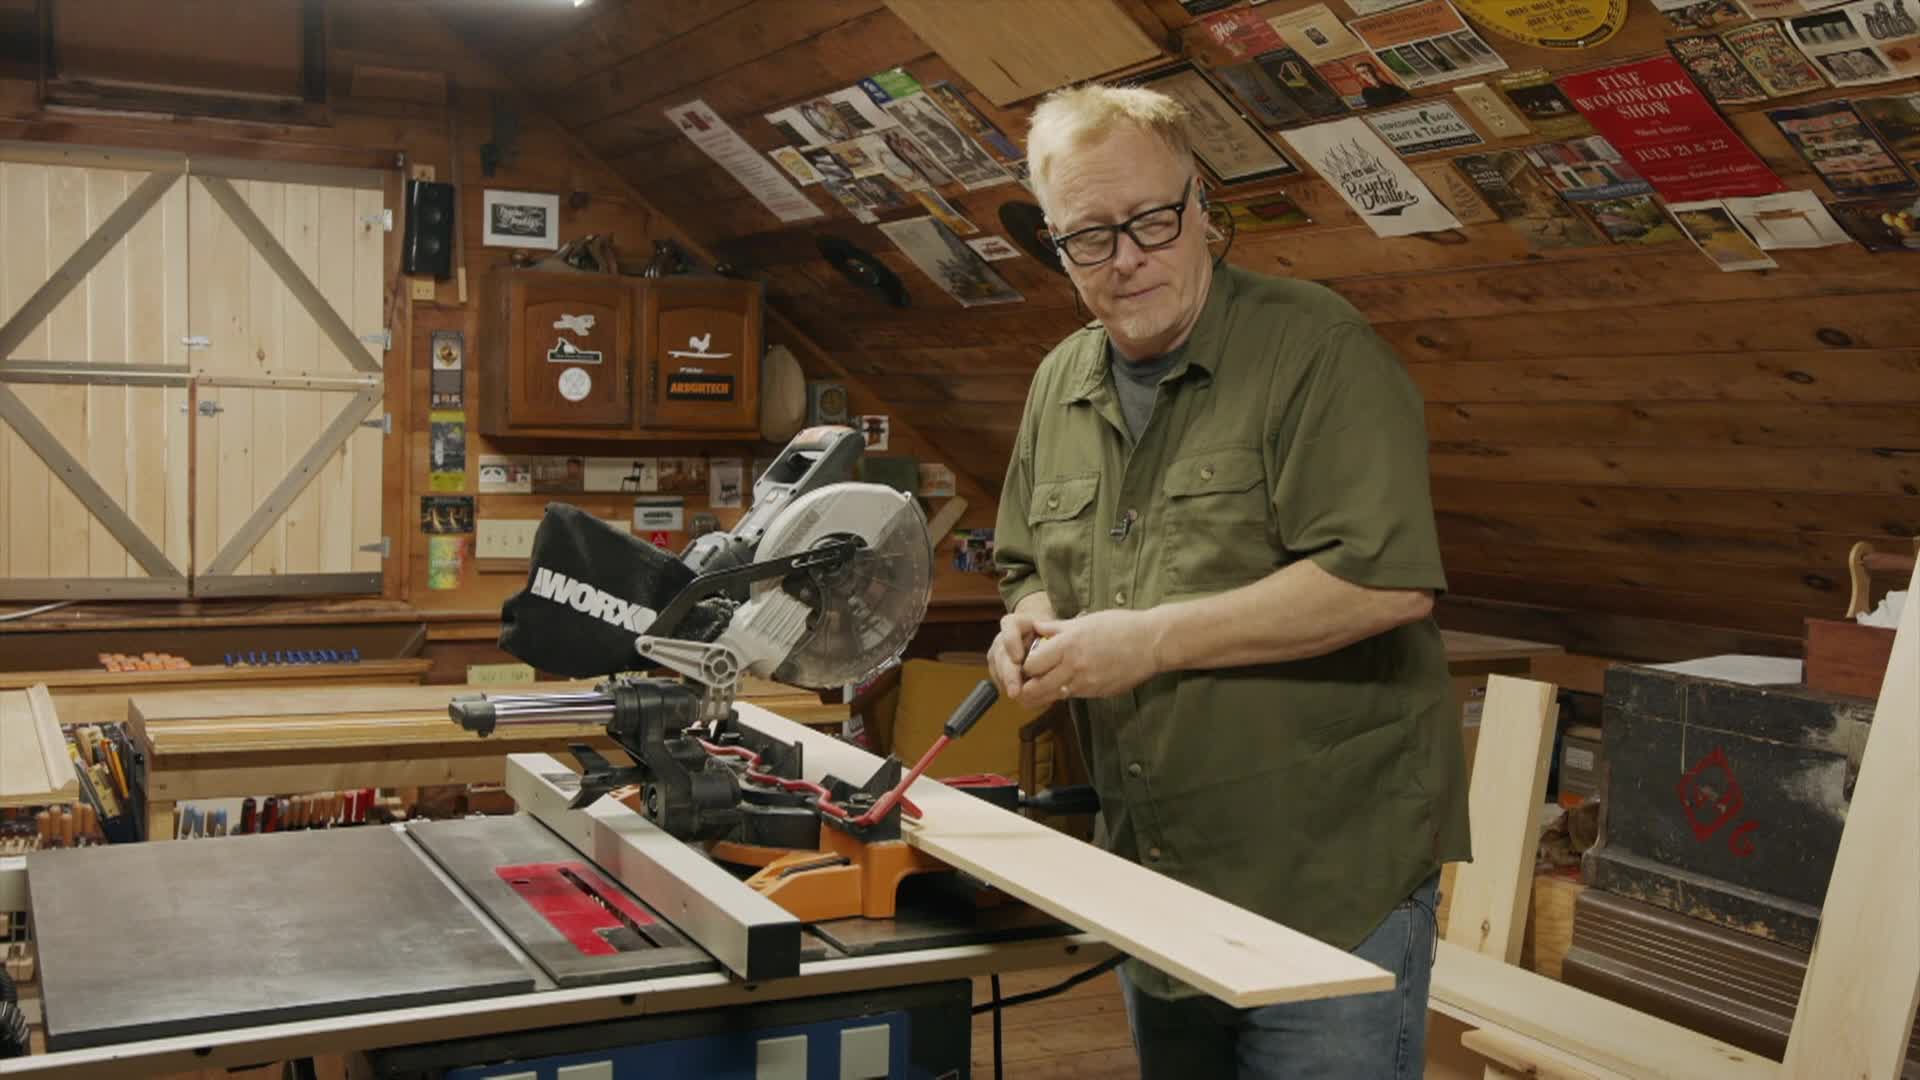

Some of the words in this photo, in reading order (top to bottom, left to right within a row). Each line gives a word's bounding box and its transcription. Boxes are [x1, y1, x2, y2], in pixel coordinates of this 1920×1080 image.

[1597, 71, 1646, 91] FINE
[1576, 79, 1694, 111] WOODWORK
[1616, 100, 1671, 120] SHOW
[1387, 129, 1412, 142] BAIT
[1635, 145, 1672, 163] JULY
[1674, 143, 1693, 157] 21
[1711, 137, 1729, 151] 22
[530, 566, 649, 635] WORX
